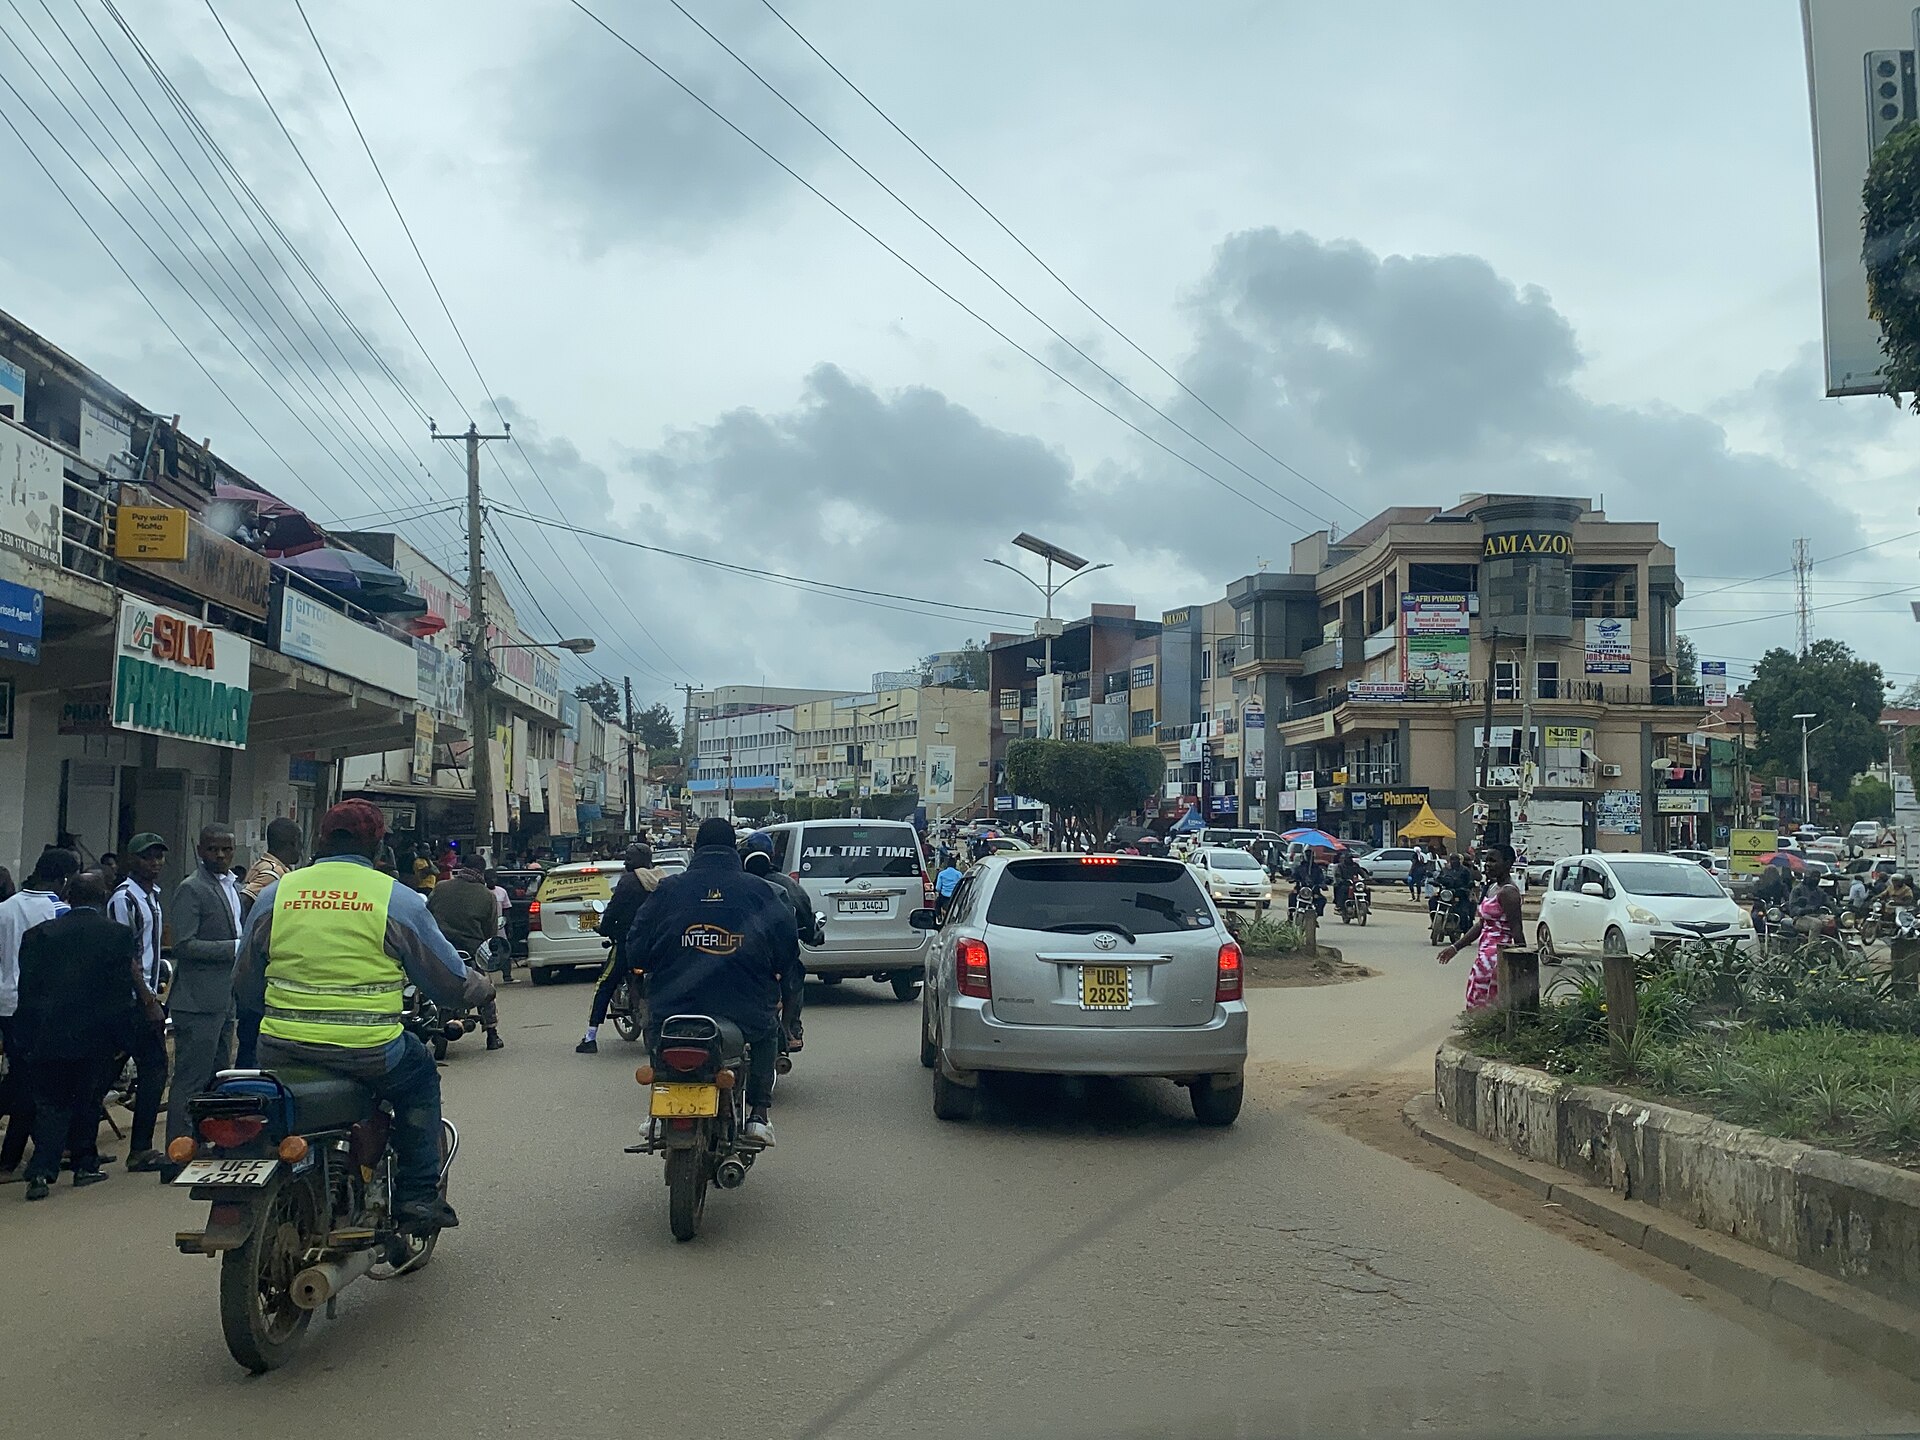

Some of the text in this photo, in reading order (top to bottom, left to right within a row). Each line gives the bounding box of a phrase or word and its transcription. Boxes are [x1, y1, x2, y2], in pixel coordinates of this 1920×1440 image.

[132, 513, 168, 522] Pay with
[136, 522, 163, 530] MoMo
[1484, 534, 1575, 556] AMAZON
[1415, 595, 1466, 603] AFRI PYRAMIDS
[15, 607, 32, 622] Agent
[1163, 611, 1188, 626] AMAZON
[152, 613, 215, 670] SILVA
[116, 655, 253, 748] PHARMACY
[1096, 724, 1125, 736] ICEA
[1383, 790, 1428, 805] Pharmacy
[1719, 828, 1727, 836] P
[802, 845, 916, 858] ALL THE TIME
[297, 890, 358, 900] TUSU
[283, 900, 374, 911] PETROLEUM
[849, 901, 883, 910] UA 144CJ
[681, 934, 745, 947] INTERLIFT
[1096, 969, 1125, 986] UBL
[1089, 987, 1126, 1004] 282S
[219, 1160, 269, 1172] UFF
